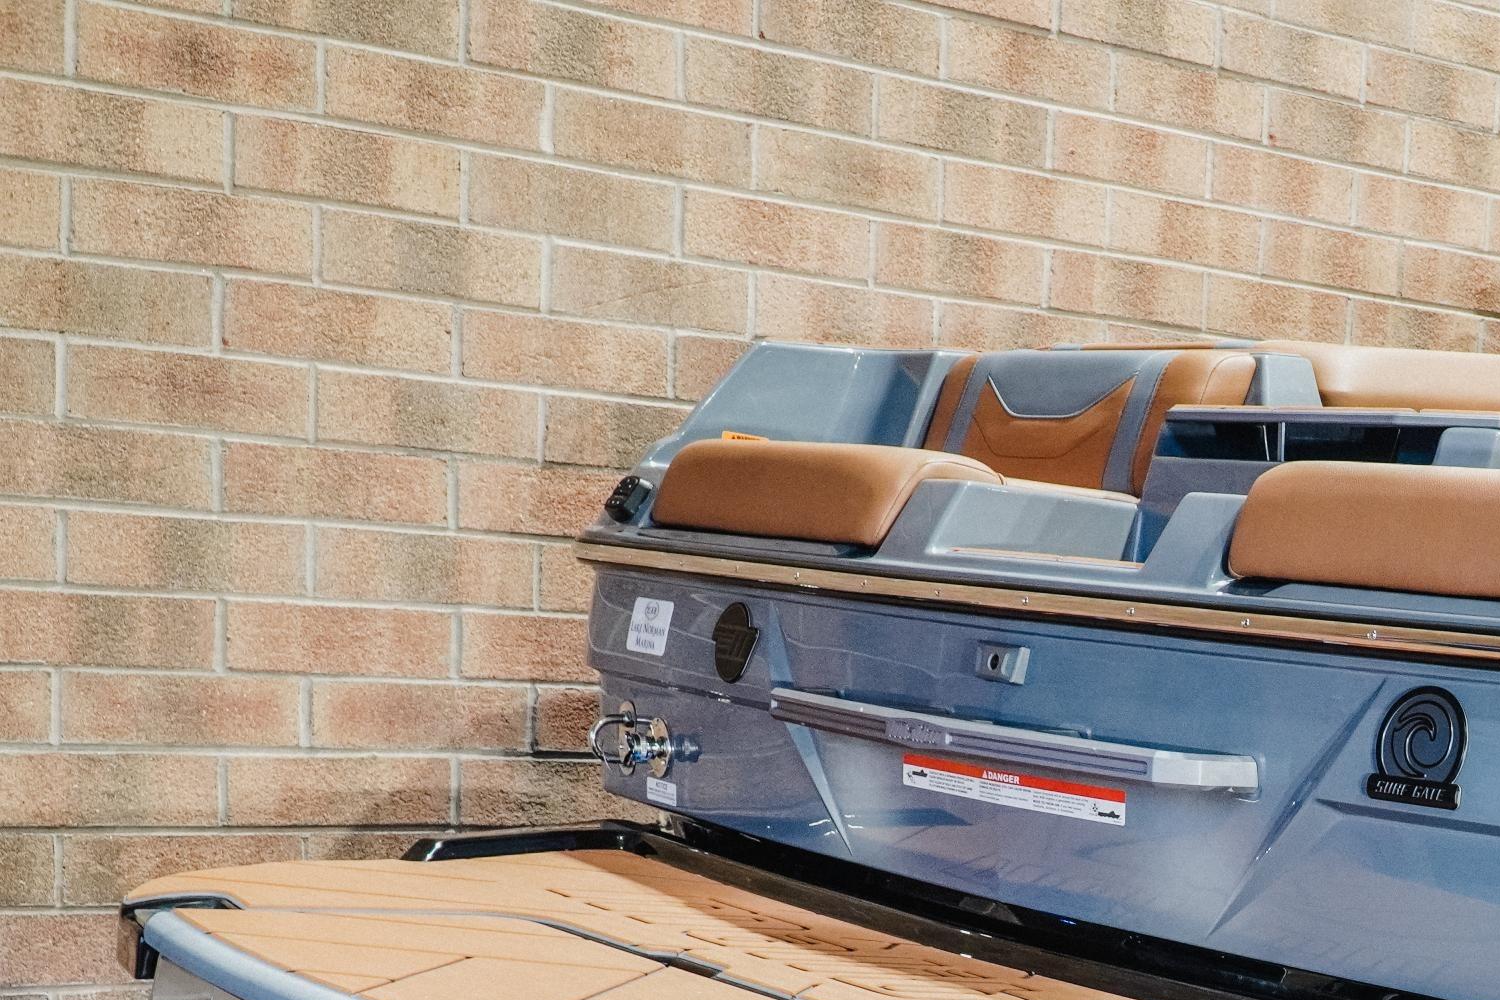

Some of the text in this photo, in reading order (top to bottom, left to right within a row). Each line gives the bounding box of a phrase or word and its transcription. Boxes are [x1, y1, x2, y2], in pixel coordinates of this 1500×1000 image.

[986, 770, 1019, 785] DANGER
[1375, 780, 1446, 801] SURF GATE
